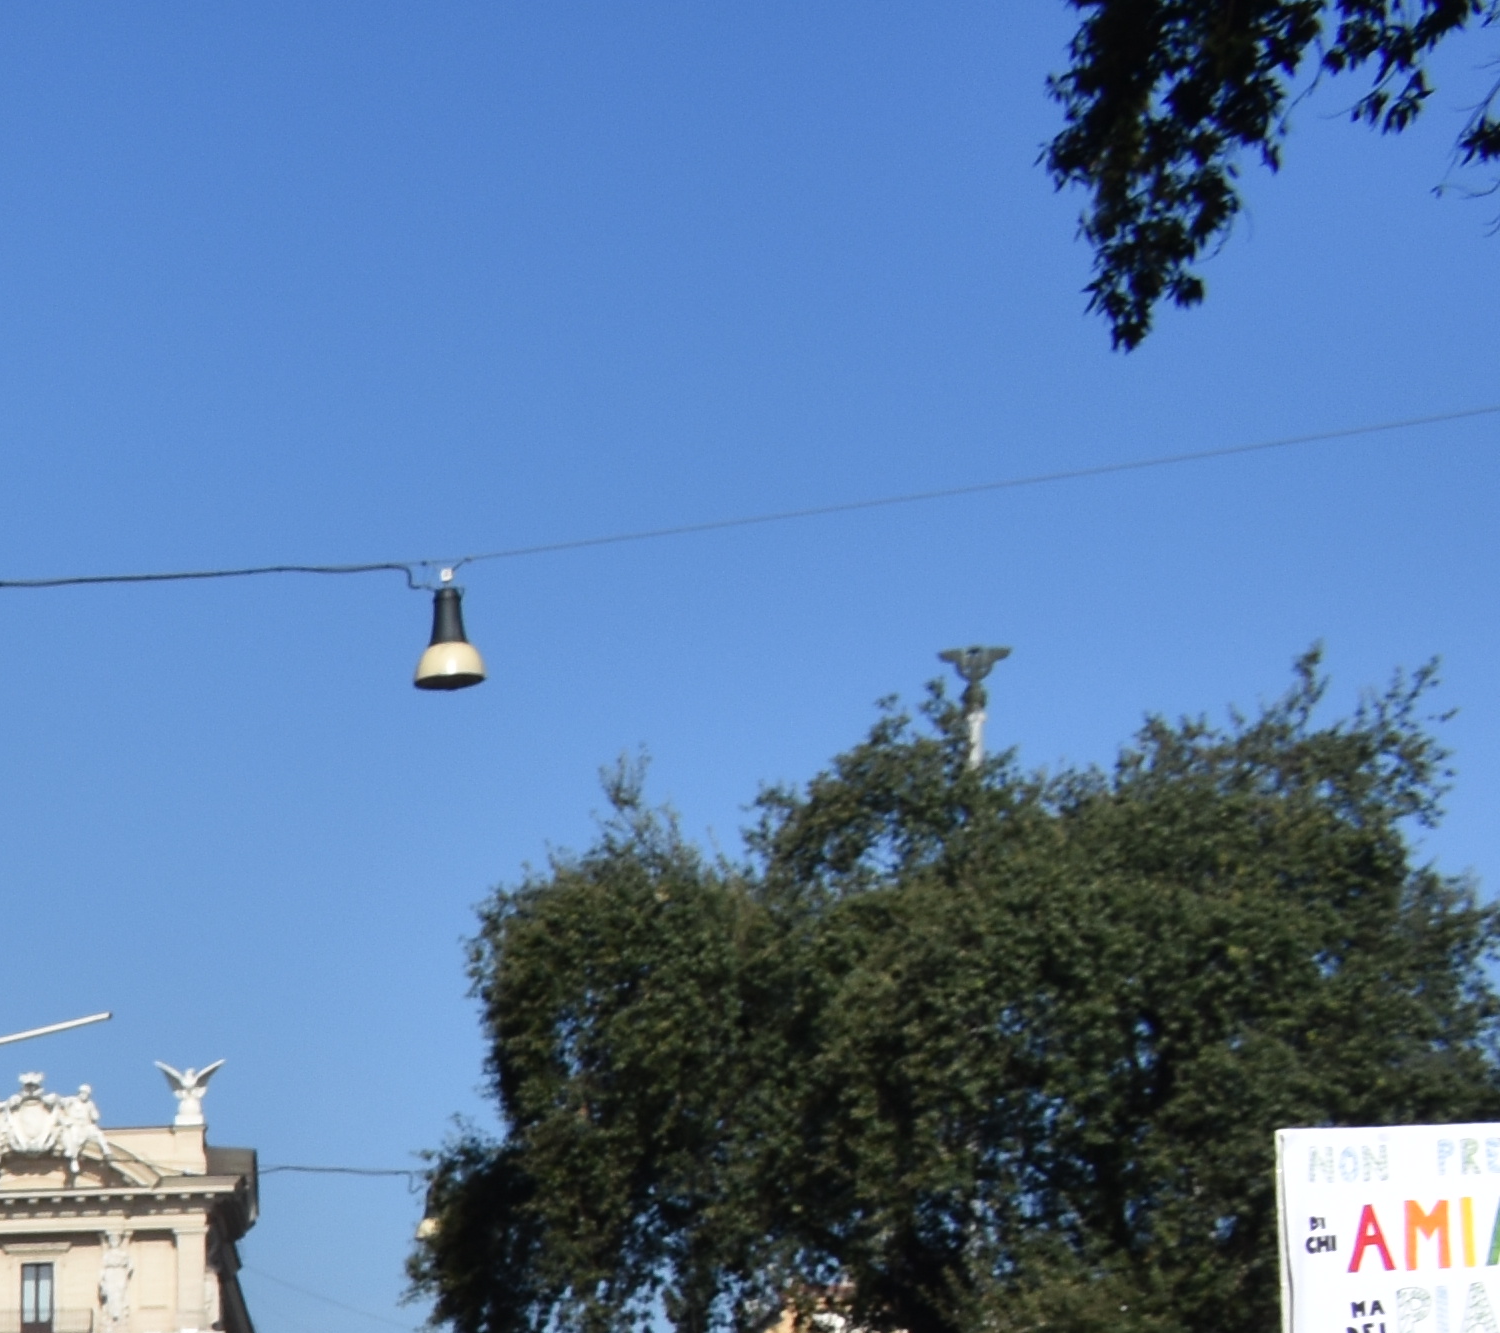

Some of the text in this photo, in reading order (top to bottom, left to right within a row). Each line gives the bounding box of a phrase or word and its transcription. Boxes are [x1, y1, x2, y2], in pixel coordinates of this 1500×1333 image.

[1307, 1143, 1390, 1184] NON
[1305, 1235, 1337, 1254] CHI
[1351, 1299, 1385, 1319] MA
